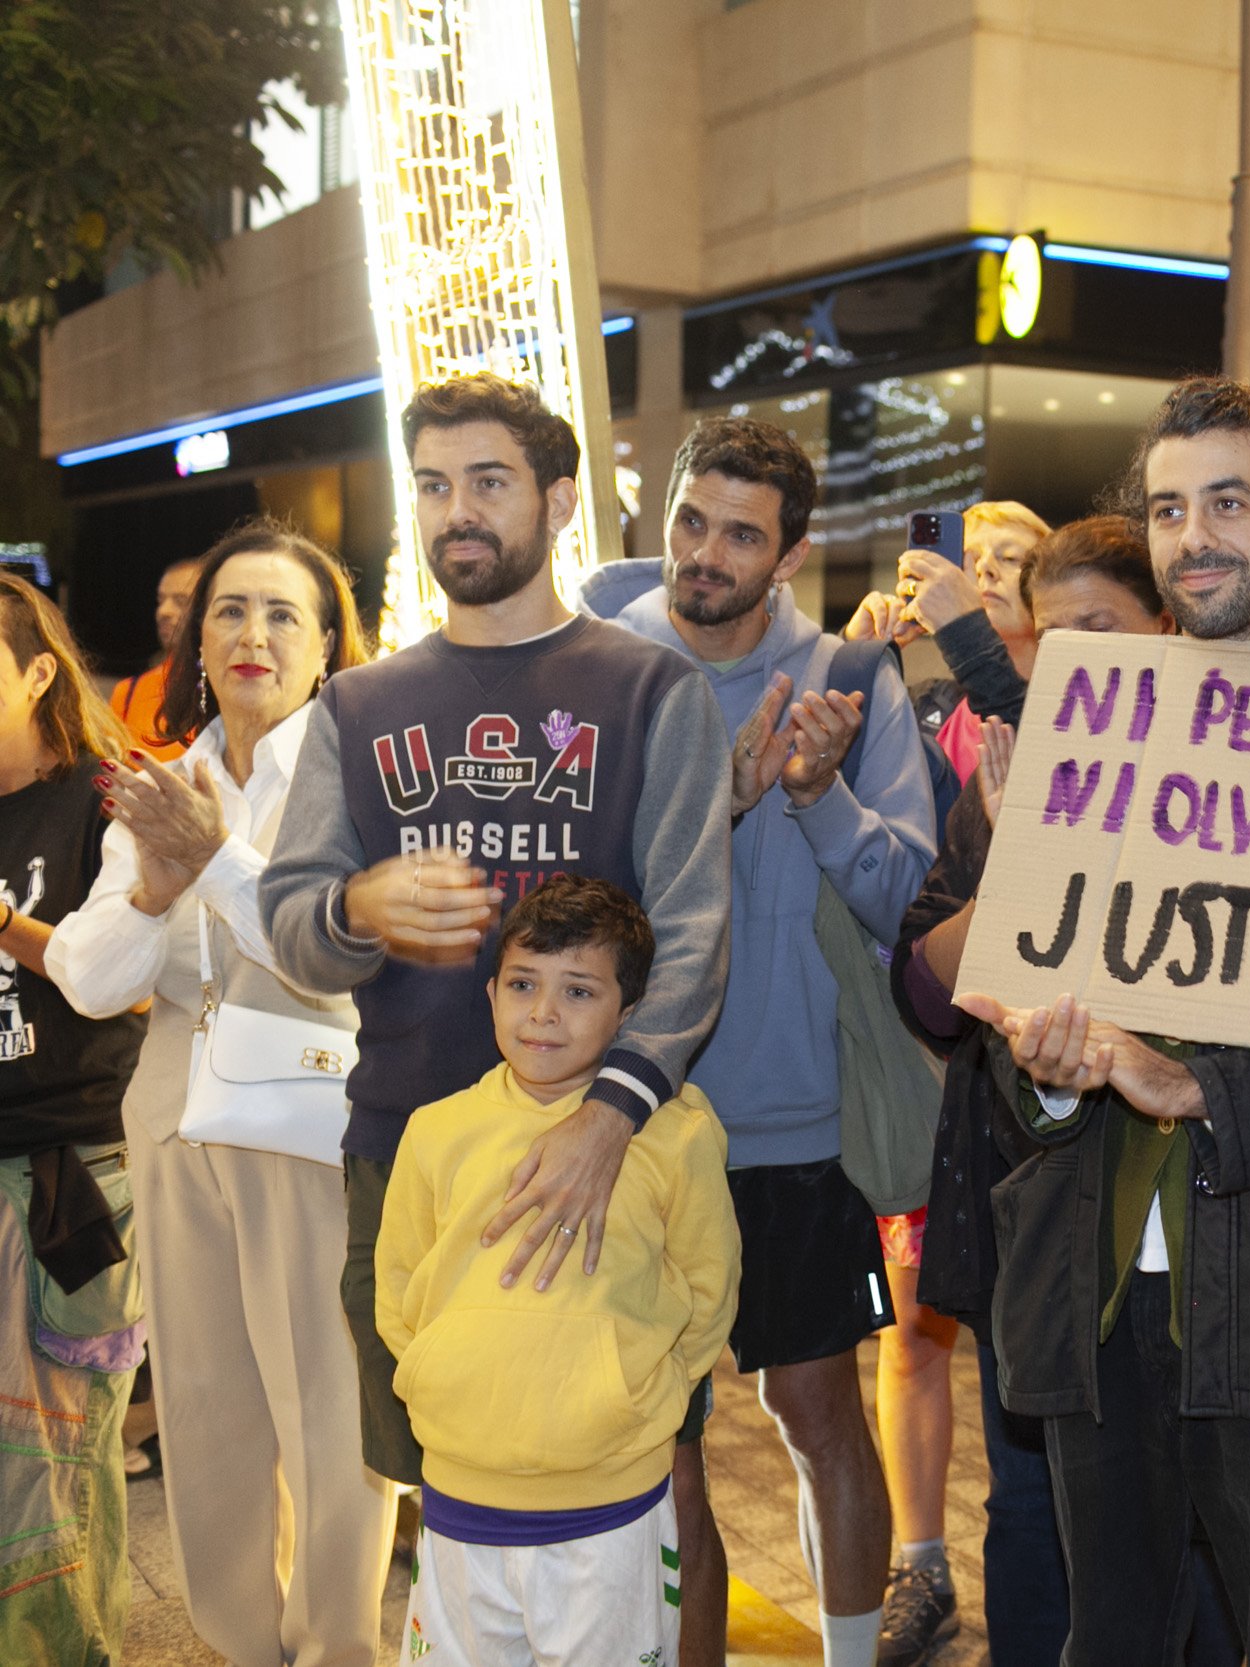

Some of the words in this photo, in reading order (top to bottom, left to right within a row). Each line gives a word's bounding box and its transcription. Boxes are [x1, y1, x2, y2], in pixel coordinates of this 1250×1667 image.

[1053, 666, 1157, 742] NI
[373, 713, 599, 816] USA
[457, 764, 488, 779] EST.
[491, 766, 523, 780] 1902
[1041, 758, 1136, 833] NI
[400, 820, 580, 863] RUSSELL
